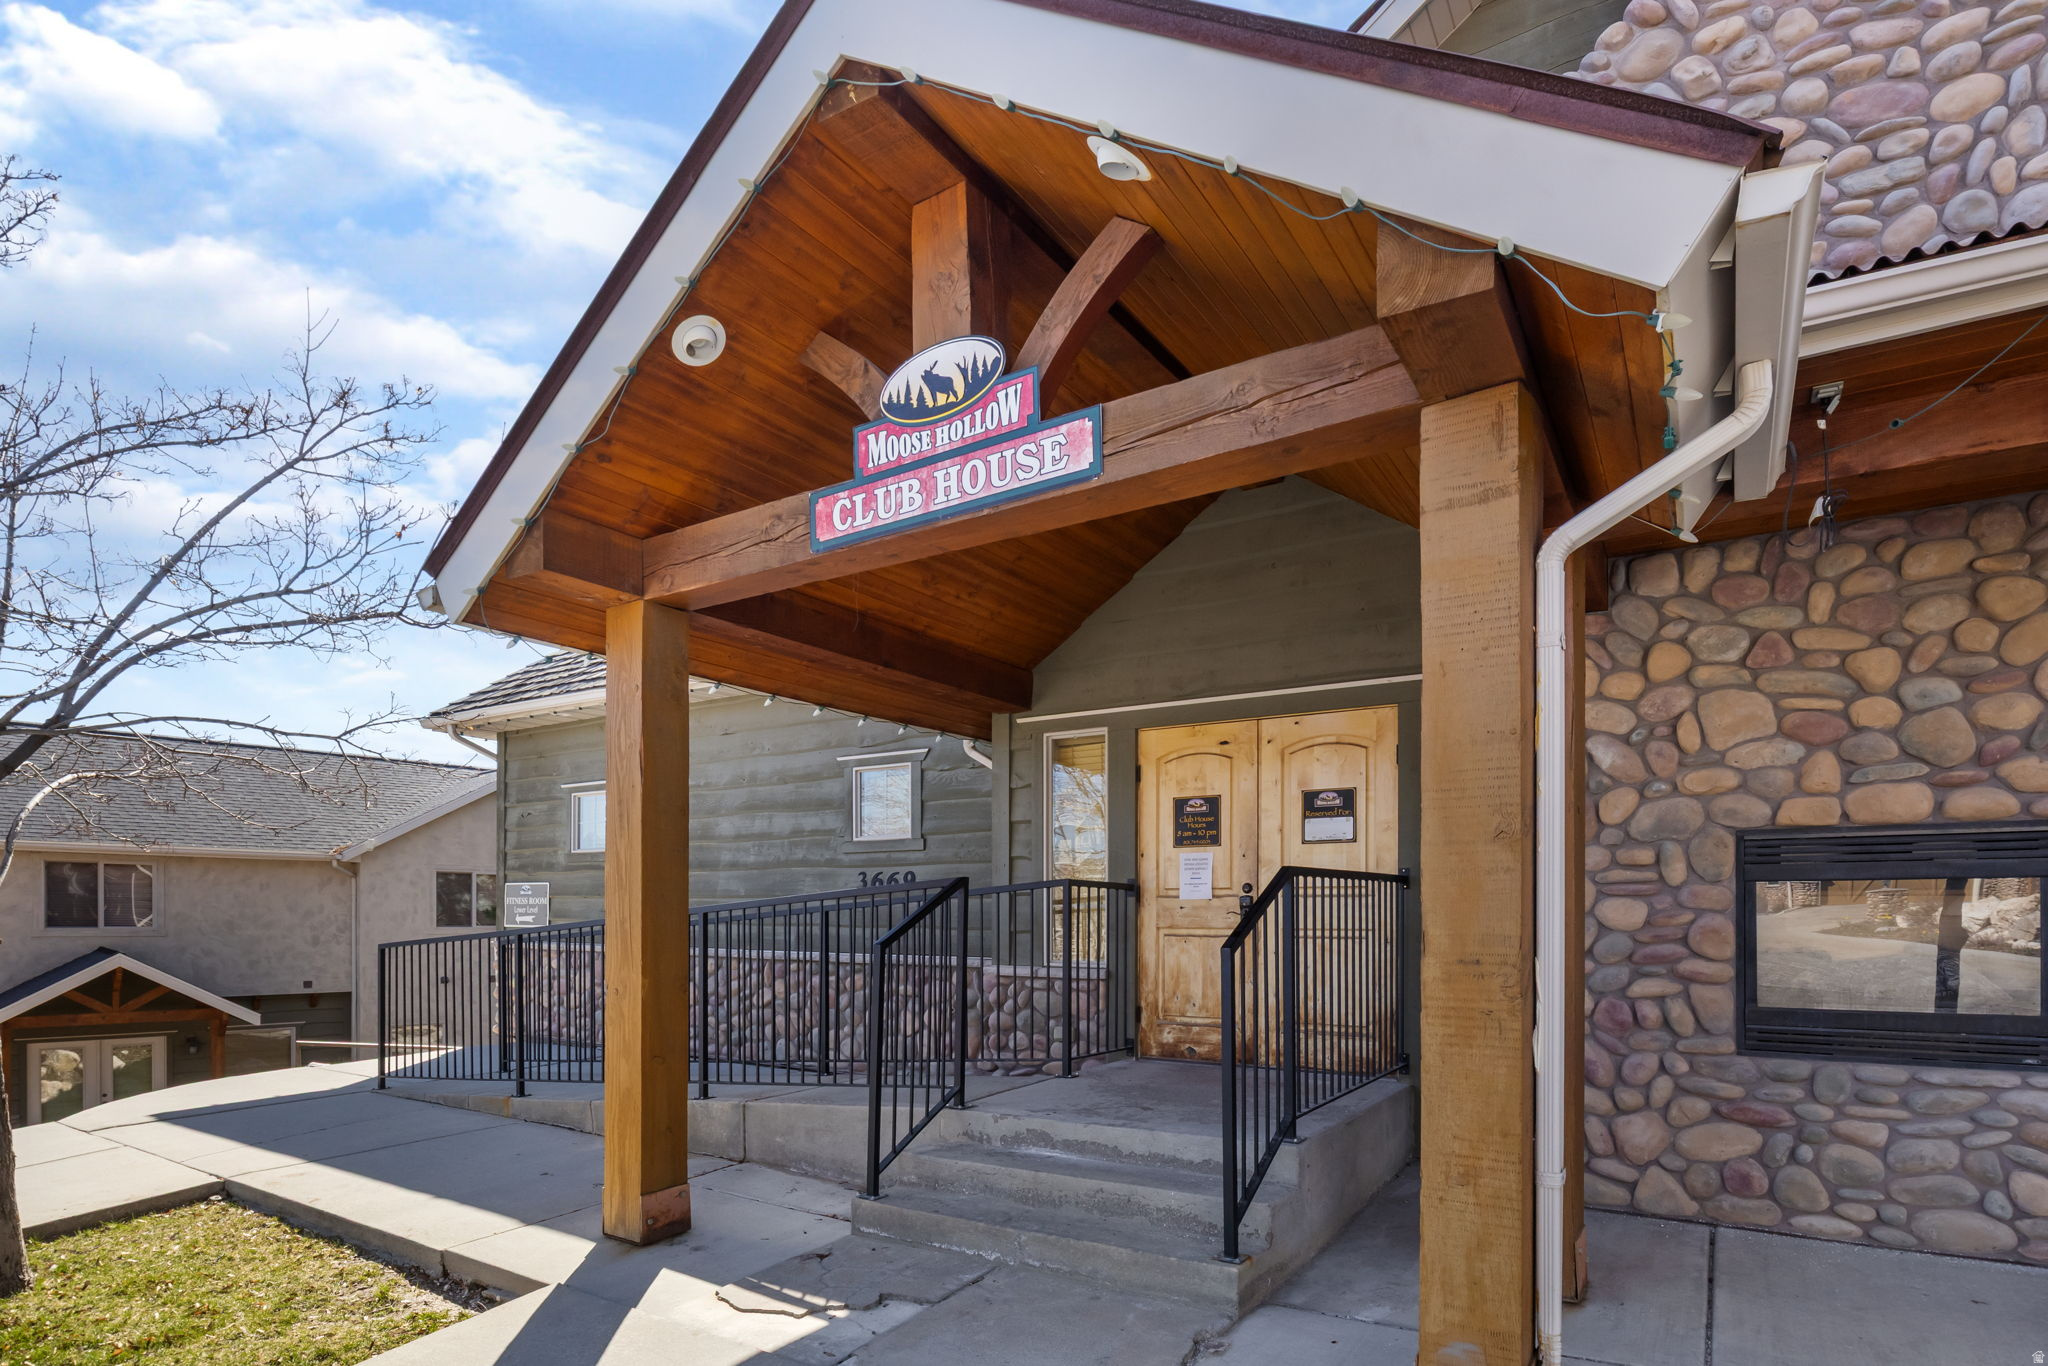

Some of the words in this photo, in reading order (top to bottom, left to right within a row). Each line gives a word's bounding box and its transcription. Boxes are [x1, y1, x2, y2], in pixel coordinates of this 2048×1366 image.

[866, 430, 932, 469] MOOSE
[934, 382, 1023, 449] HOLLOW
[832, 478, 924, 531] CLUB
[933, 432, 1071, 505] HOUSE
[1206, 830, 1217, 839] pm
[506, 896, 528, 905] FITNESS
[528, 896, 548, 905] ROOM
